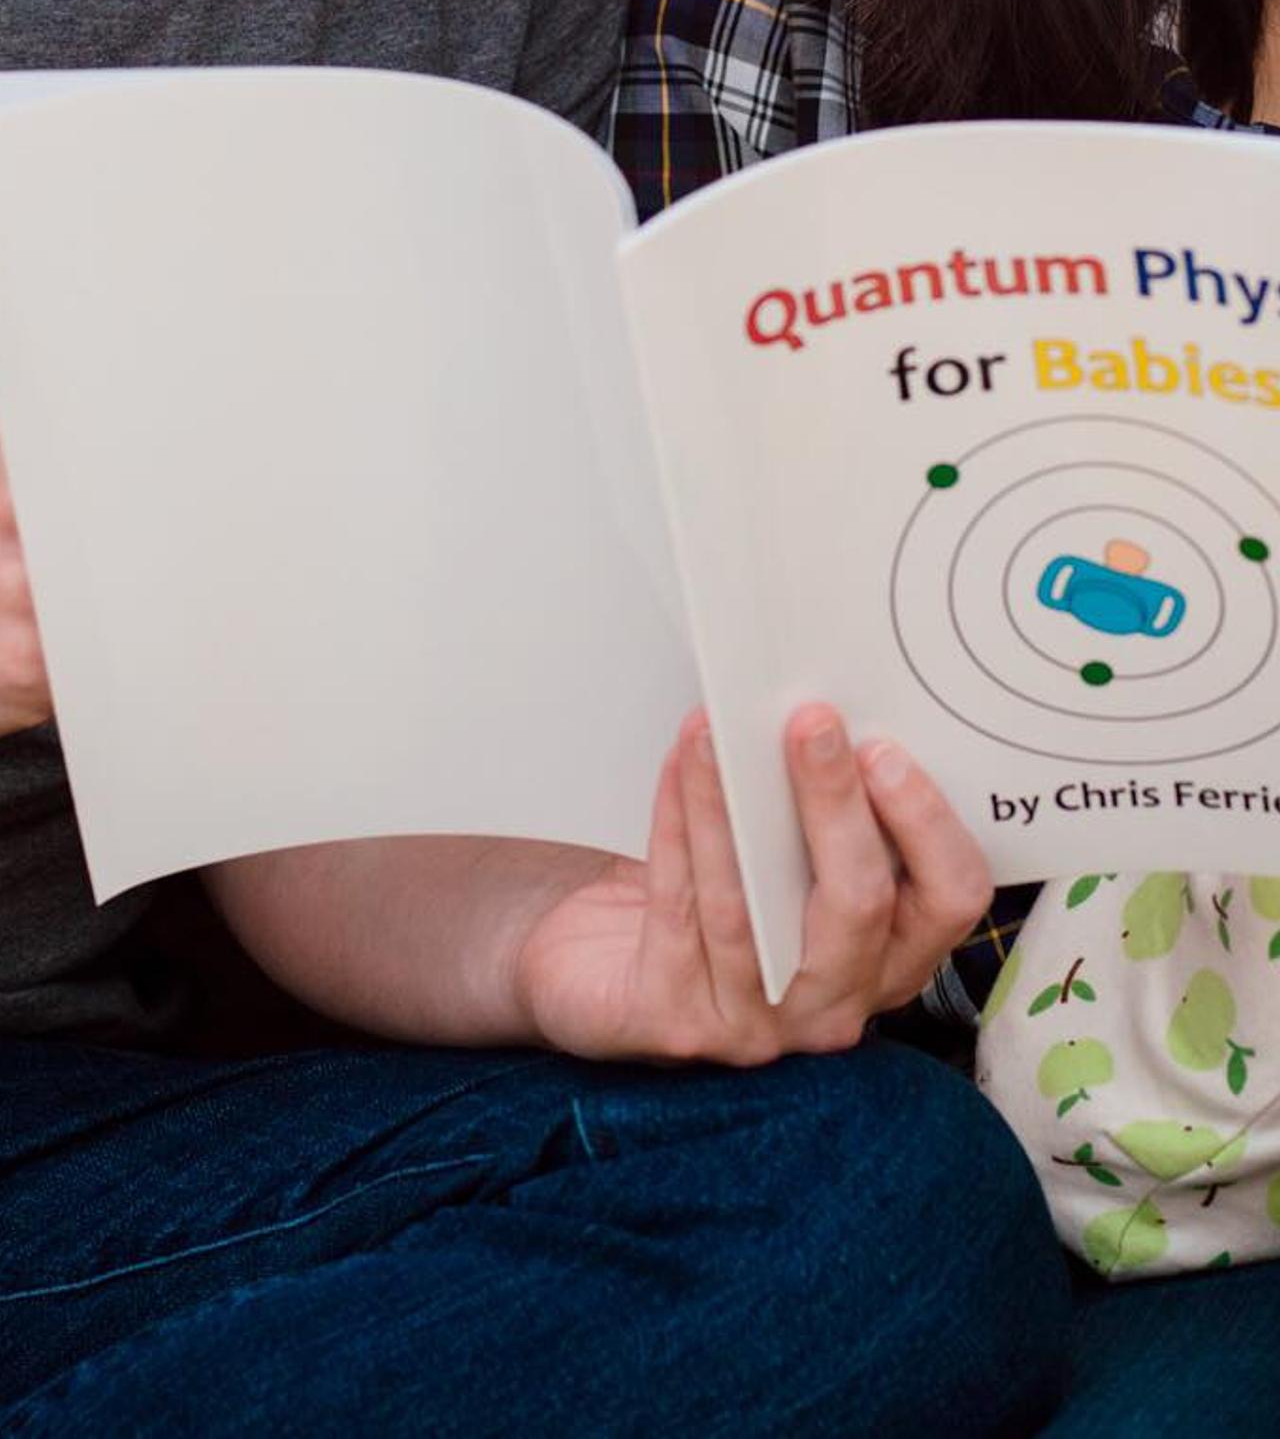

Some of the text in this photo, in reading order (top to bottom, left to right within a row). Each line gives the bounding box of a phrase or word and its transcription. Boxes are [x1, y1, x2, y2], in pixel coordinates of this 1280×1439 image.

[744, 249, 1109, 352] Quantum
[889, 347, 1007, 402] for
[990, 792, 1040, 825] by
[1054, 779, 1161, 812] Chris
